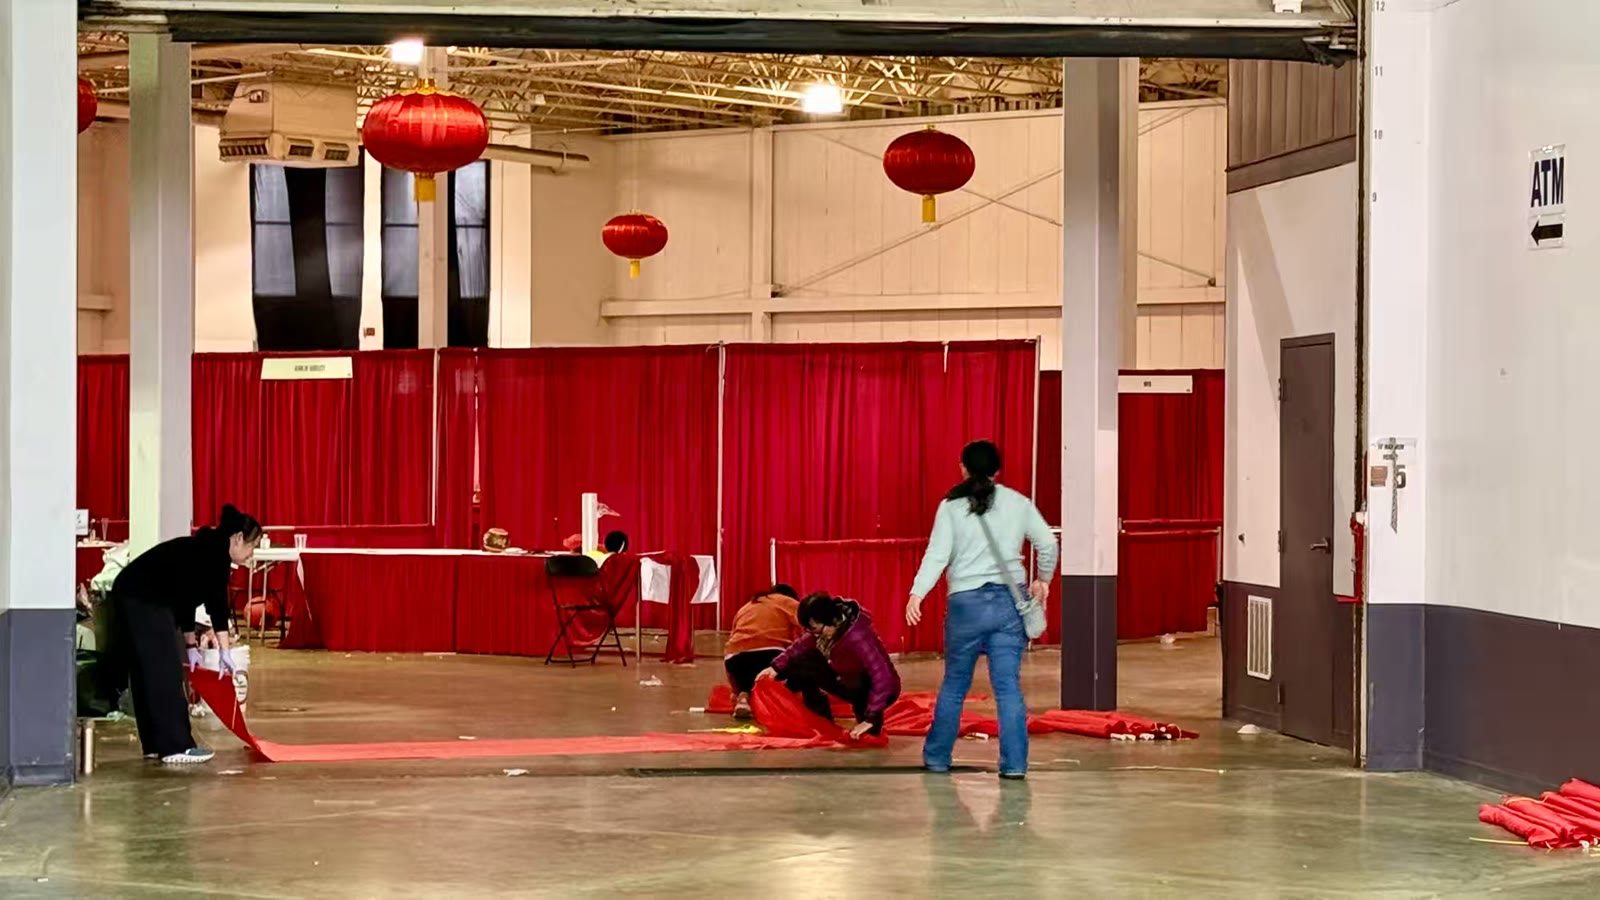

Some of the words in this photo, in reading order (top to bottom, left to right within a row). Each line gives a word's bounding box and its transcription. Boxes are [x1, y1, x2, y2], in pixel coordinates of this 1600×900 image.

[1376, 1, 1385, 11] 12
[1375, 66, 1383, 76] 11
[1374, 129, 1383, 140] 10
[1531, 156, 1564, 208] ATM
[1372, 192, 1377, 202] 9
